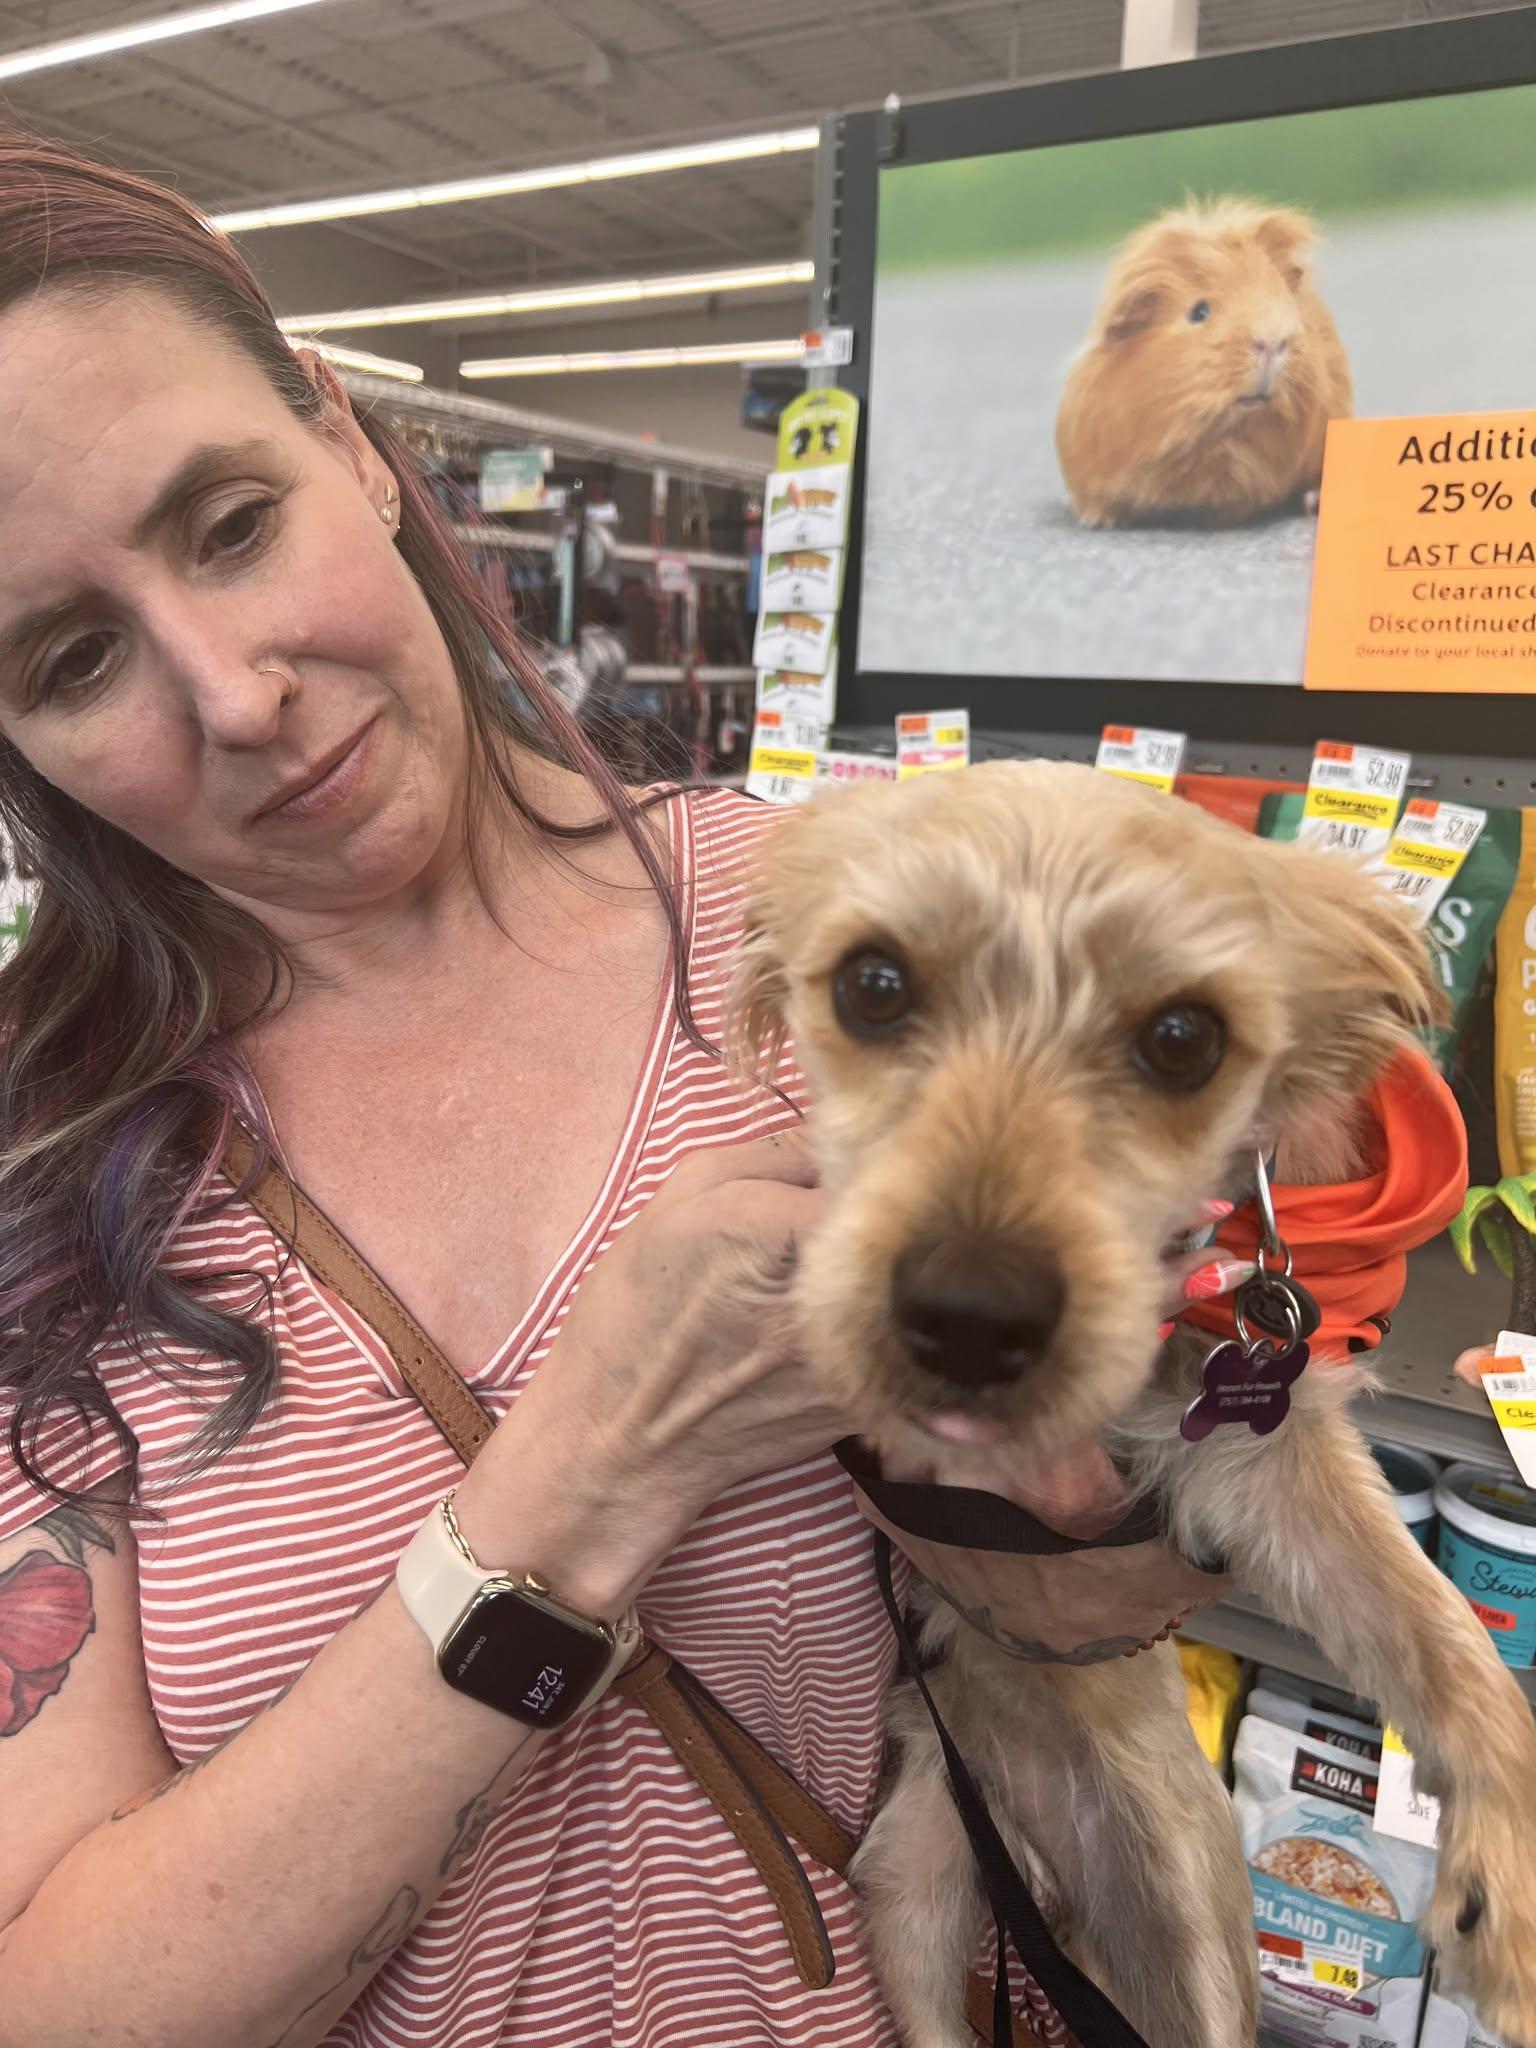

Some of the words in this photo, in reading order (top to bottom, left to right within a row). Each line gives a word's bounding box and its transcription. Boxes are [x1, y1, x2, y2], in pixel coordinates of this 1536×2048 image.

[1417, 480, 1513, 514] 25%
[1386, 543, 1460, 567] LAST
[1470, 541, 1536, 565] CHA
[1368, 612, 1536, 632] Discontinued
[1356, 644, 1409, 657] Donate
[1415, 645, 1430, 656] to
[1435, 647, 1470, 659] your
[1476, 643, 1514, 657] local
[1315, 793, 1388, 815] Clearance
[1393, 846, 1456, 867] Clearance
[1506, 1407, 1536, 1418] Cle
[464, 1636, 486, 1664] CLOUDY
[522, 1665, 563, 1709] 12:41
[1314, 1762, 1363, 1797] KOHA
[1253, 1895, 1328, 1941] BLAND
[1334, 1926, 1388, 1963] DIET
